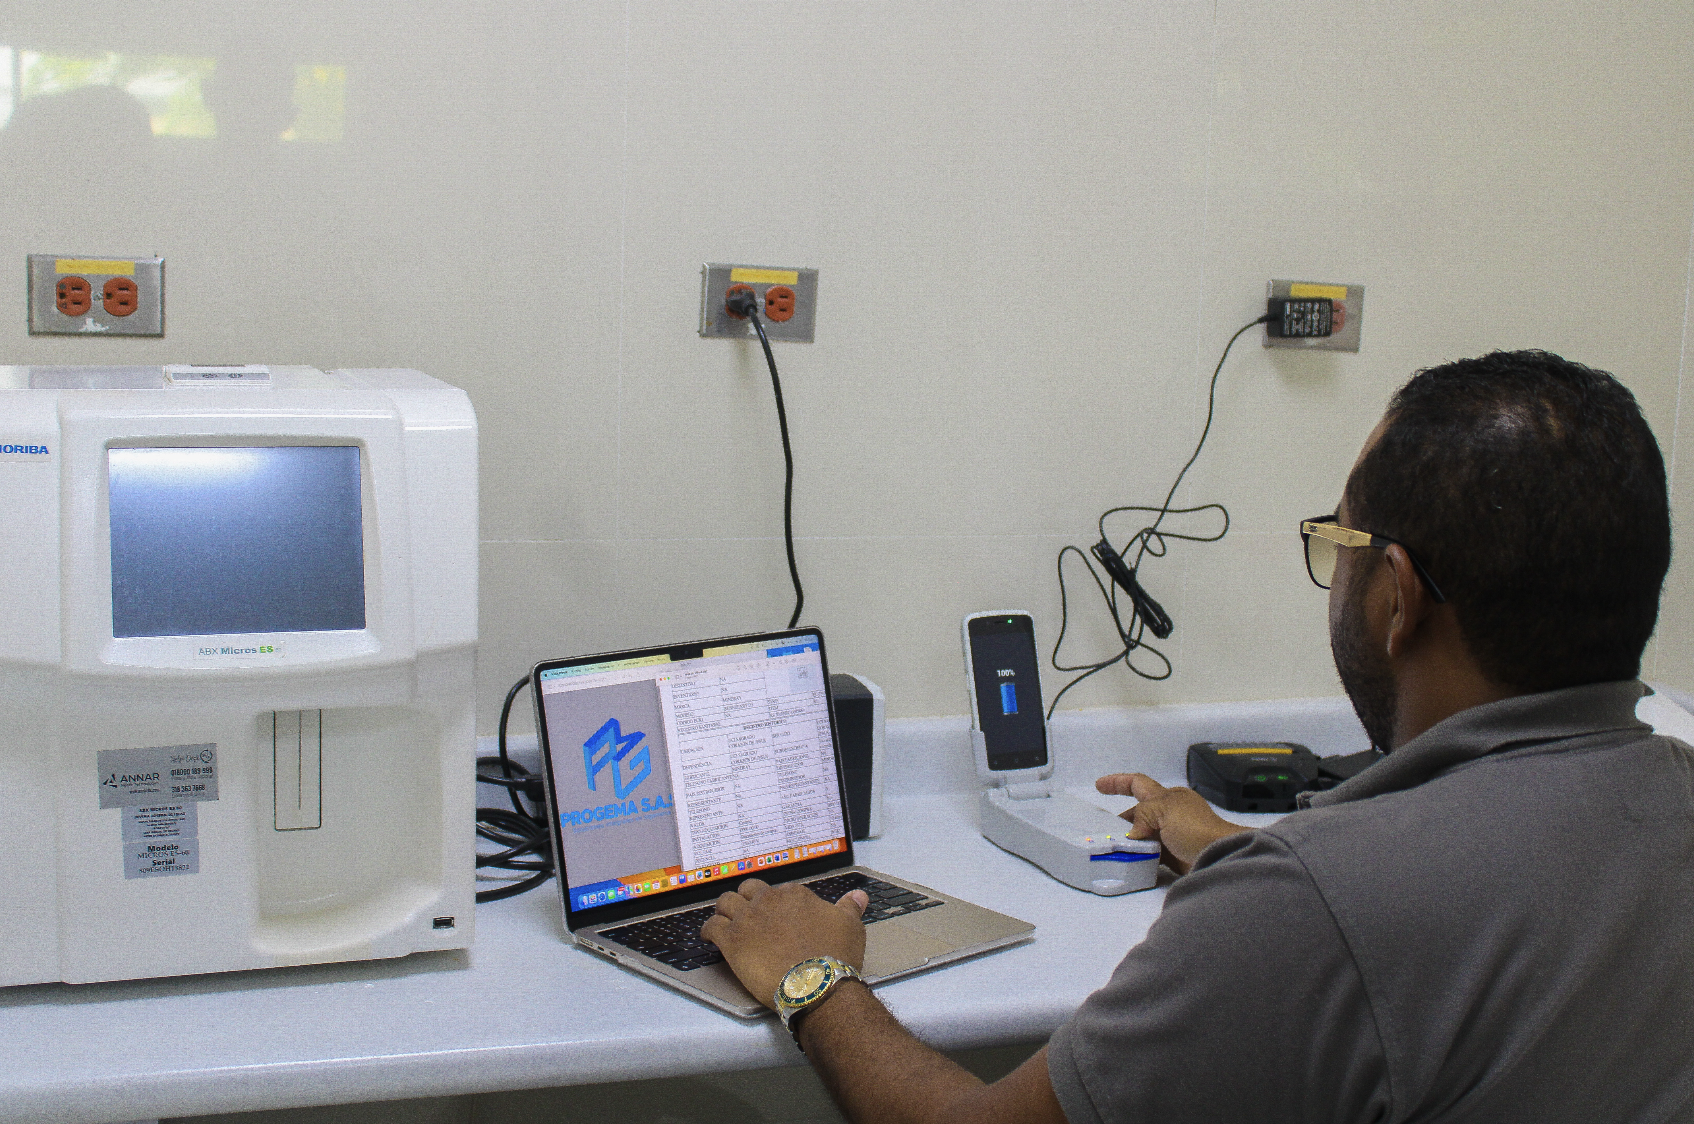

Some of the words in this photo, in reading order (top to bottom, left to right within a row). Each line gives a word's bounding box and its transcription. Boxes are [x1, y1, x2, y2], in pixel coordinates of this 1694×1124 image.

[0, 444, 50, 454] ORIBA
[198, 647, 219, 656] ABX
[221, 646, 258, 655] Micros
[259, 645, 274, 653] ES
[996, 668, 1015, 677] 100%
[120, 772, 160, 783] ANNAR
[560, 801, 638, 828] PROGEMA
[147, 843, 179, 852] Modelo
[152, 858, 175, 867] Serial
